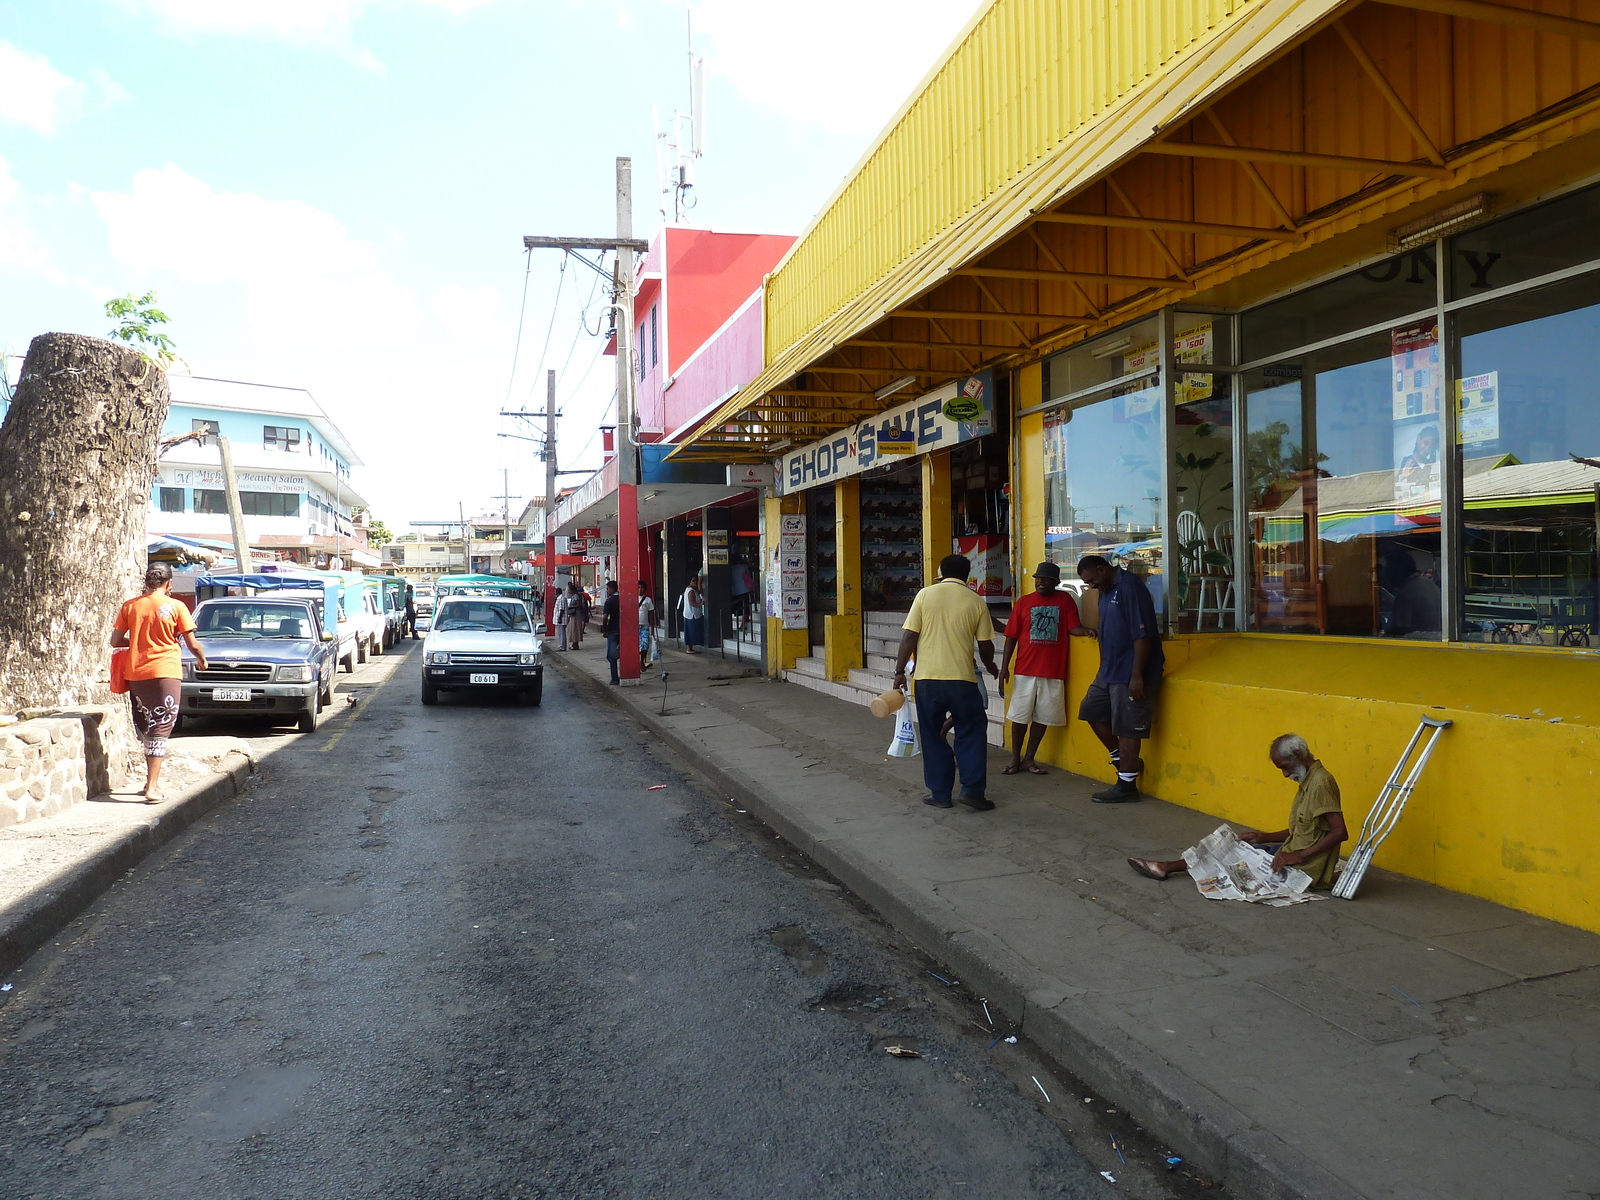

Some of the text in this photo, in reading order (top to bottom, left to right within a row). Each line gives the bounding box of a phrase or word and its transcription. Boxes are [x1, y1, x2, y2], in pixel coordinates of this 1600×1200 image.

[1264, 365, 1302, 377] combos
[789, 436, 848, 488] SHOP
[849, 442, 857, 458] N
[177, 473, 191, 484] M
[243, 473, 277, 484] Beauty
[279, 474, 304, 484] Salon
[787, 558, 801, 567] fmf
[788, 596, 802, 606] fmf
[220, 692, 248, 700] DH 321
